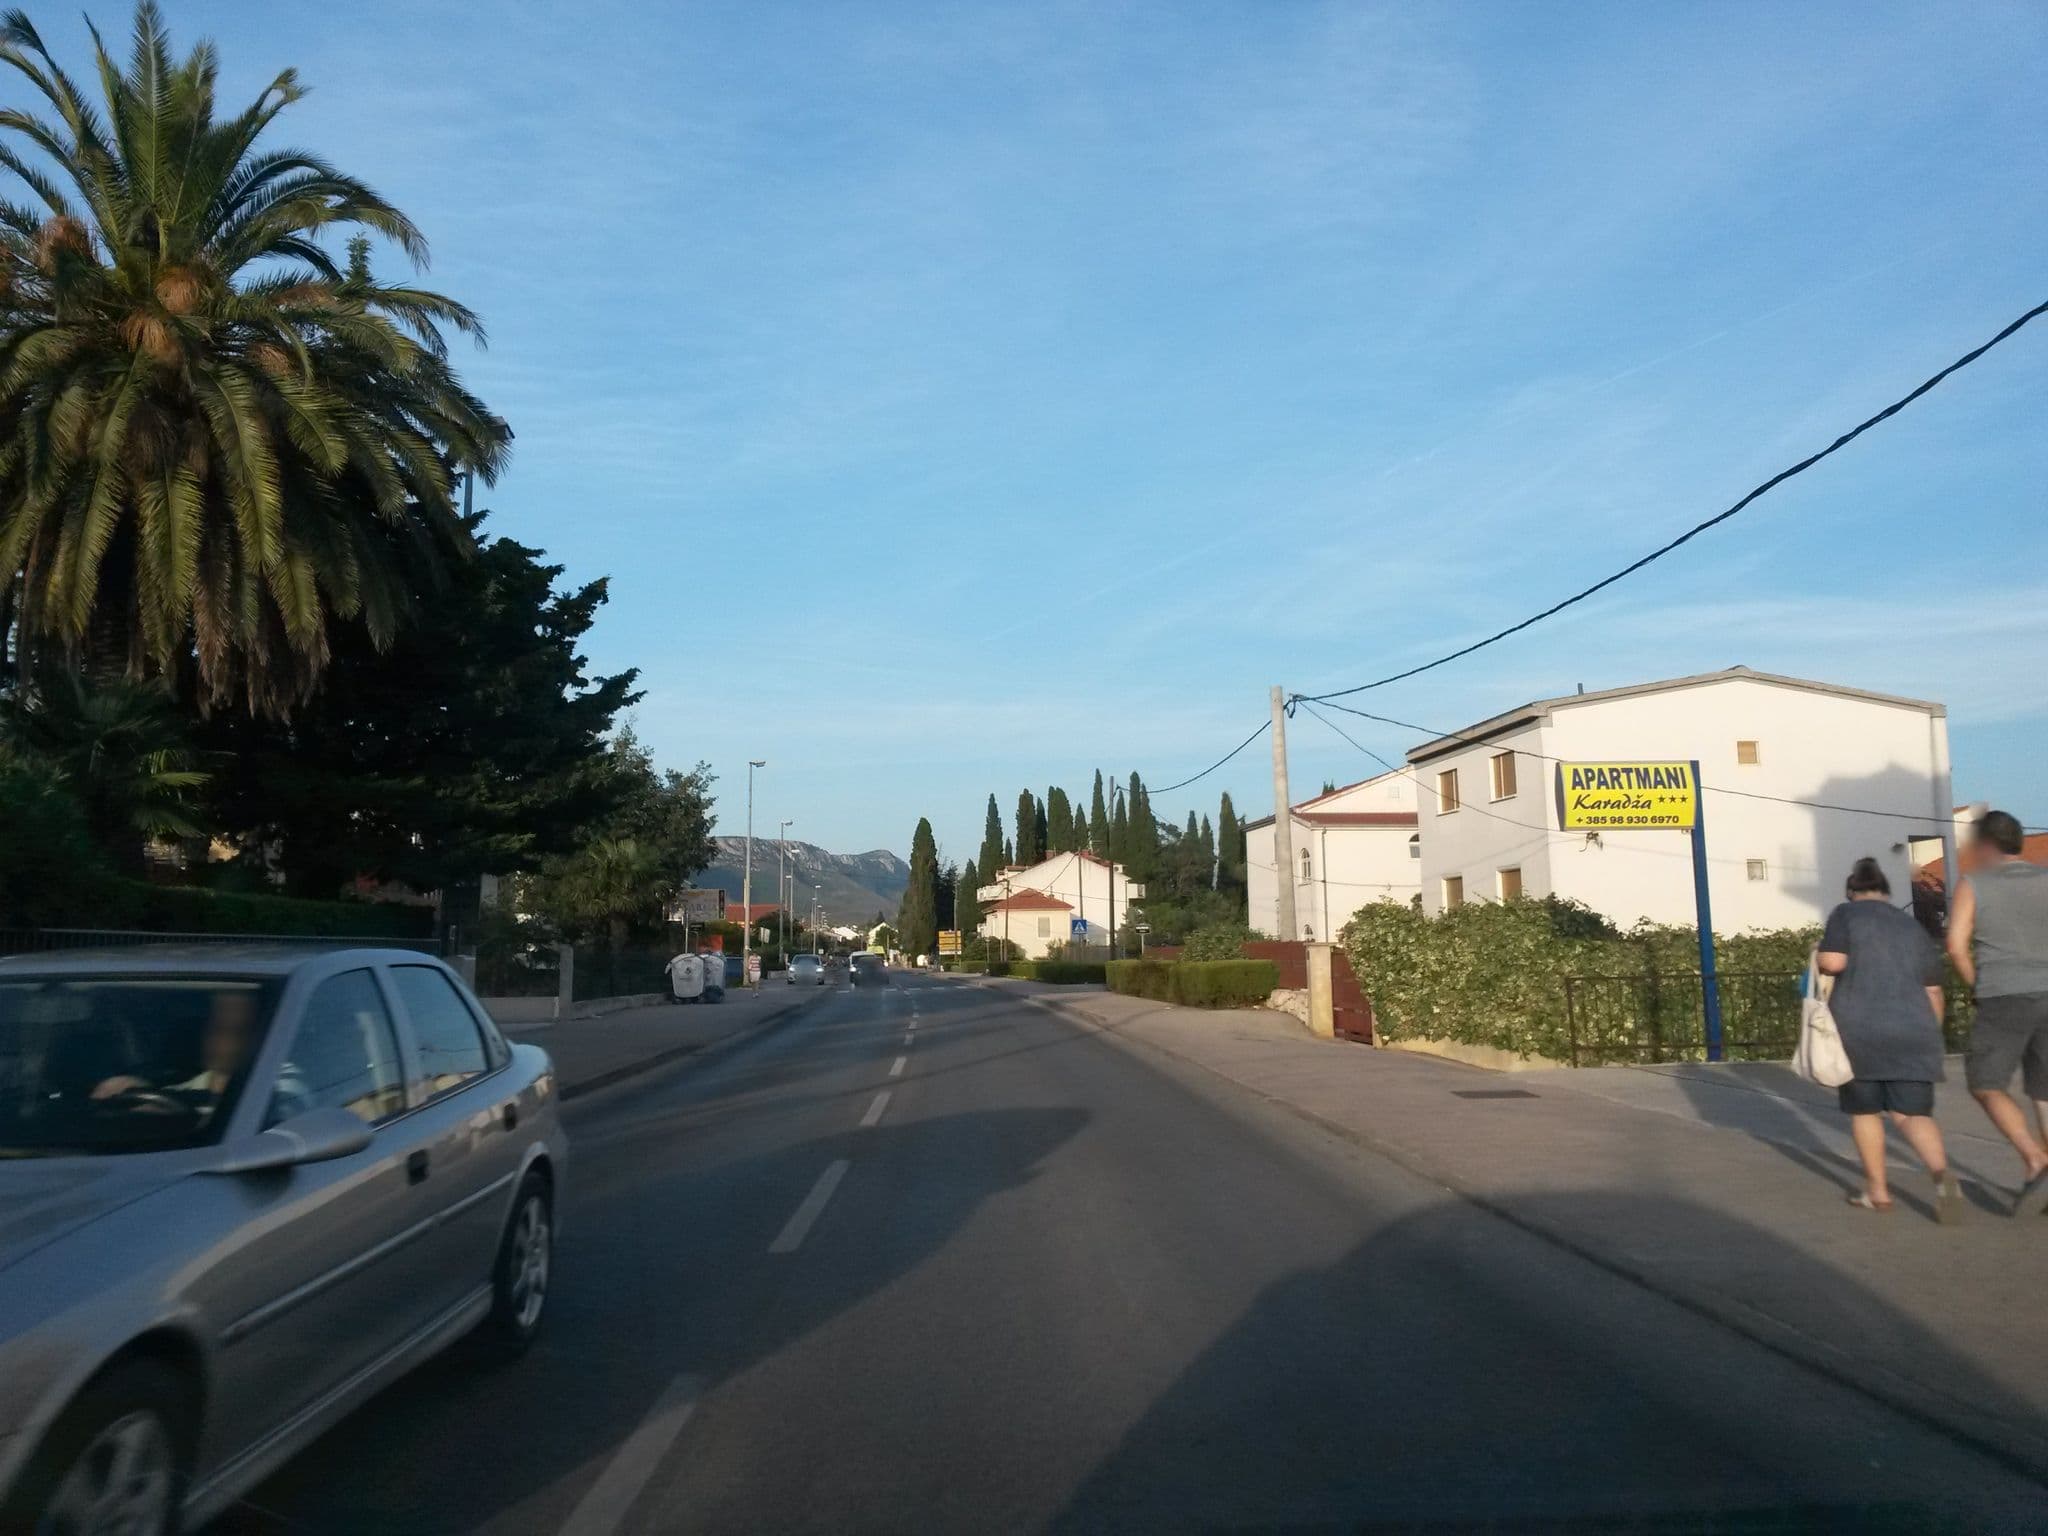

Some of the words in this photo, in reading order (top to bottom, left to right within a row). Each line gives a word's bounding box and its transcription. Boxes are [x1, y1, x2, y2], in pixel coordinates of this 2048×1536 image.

[1572, 767, 1687, 790] APARTMANI
[1573, 793, 1651, 810] Karadža
[1586, 816, 1607, 824] 385
[1609, 816, 1624, 824] 98
[1626, 816, 1648, 824] 930
[1650, 815, 1679, 824] 6970
